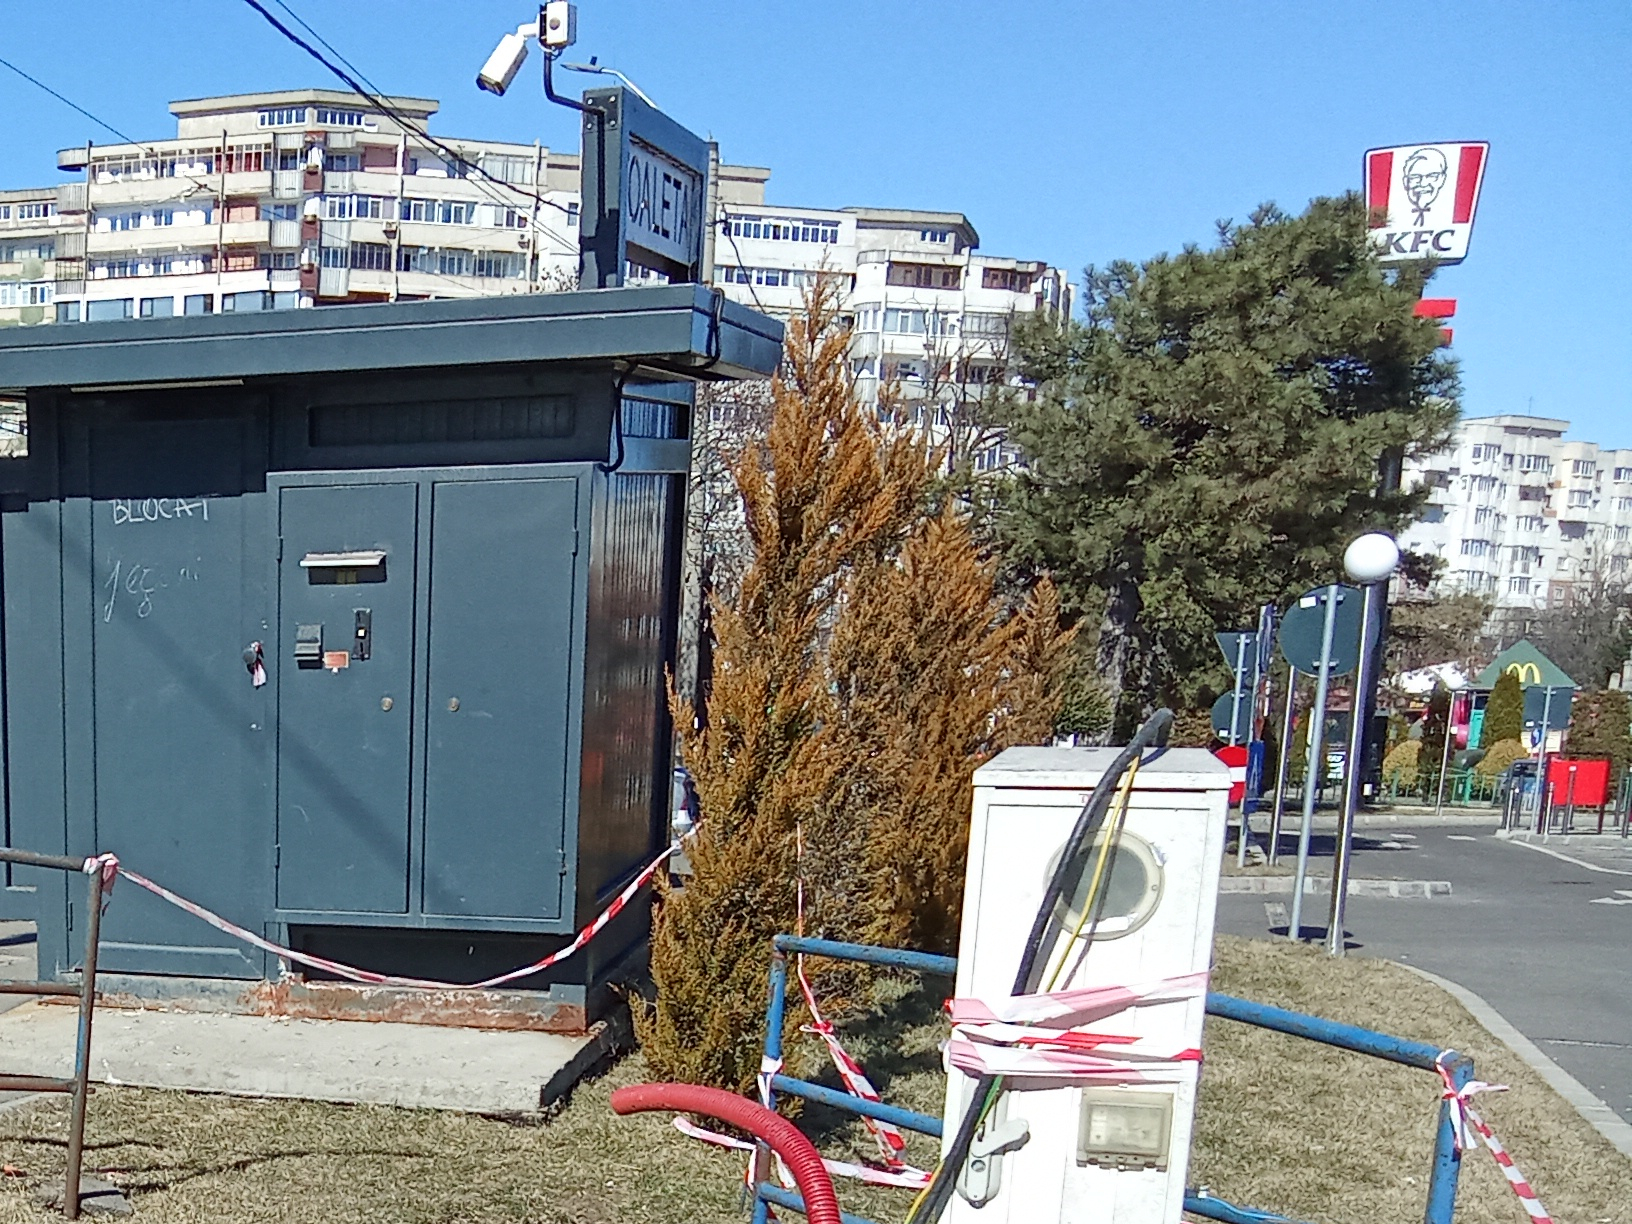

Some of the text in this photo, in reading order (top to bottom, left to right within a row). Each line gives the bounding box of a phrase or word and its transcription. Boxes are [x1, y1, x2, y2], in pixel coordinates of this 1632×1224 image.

[627, 155, 689, 245] OALETA
[1377, 229, 1456, 256] KFC
[111, 498, 209, 524] BLOCAT
